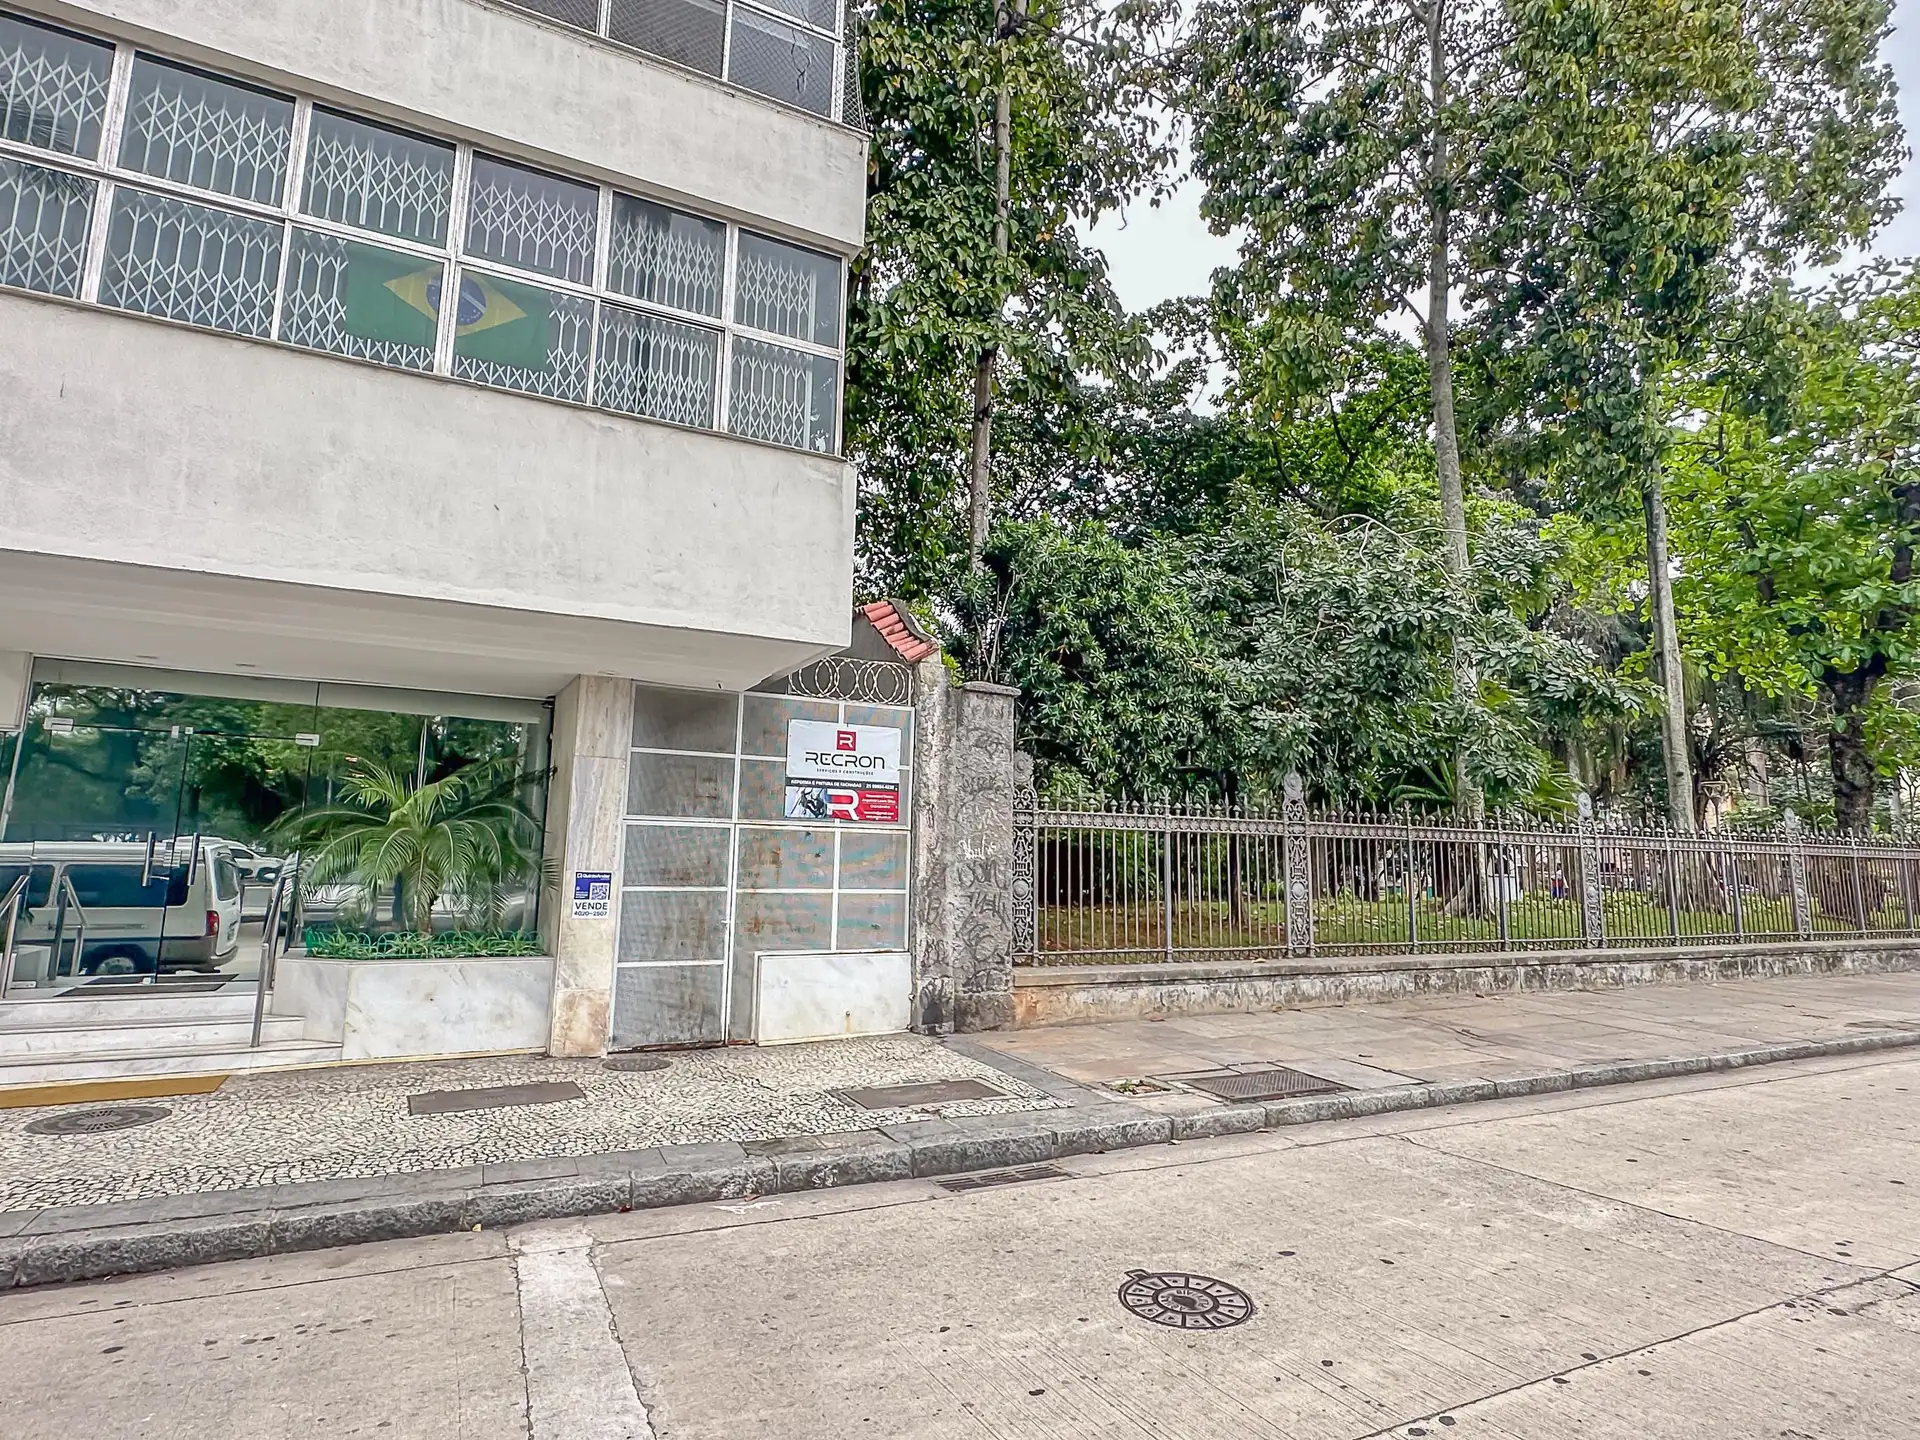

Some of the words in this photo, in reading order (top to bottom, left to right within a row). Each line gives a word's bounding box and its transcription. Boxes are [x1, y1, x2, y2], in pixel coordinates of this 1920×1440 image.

[839, 734, 853, 748] R
[805, 751, 885, 769] RECRON
[575, 902, 608, 910] VENDE
